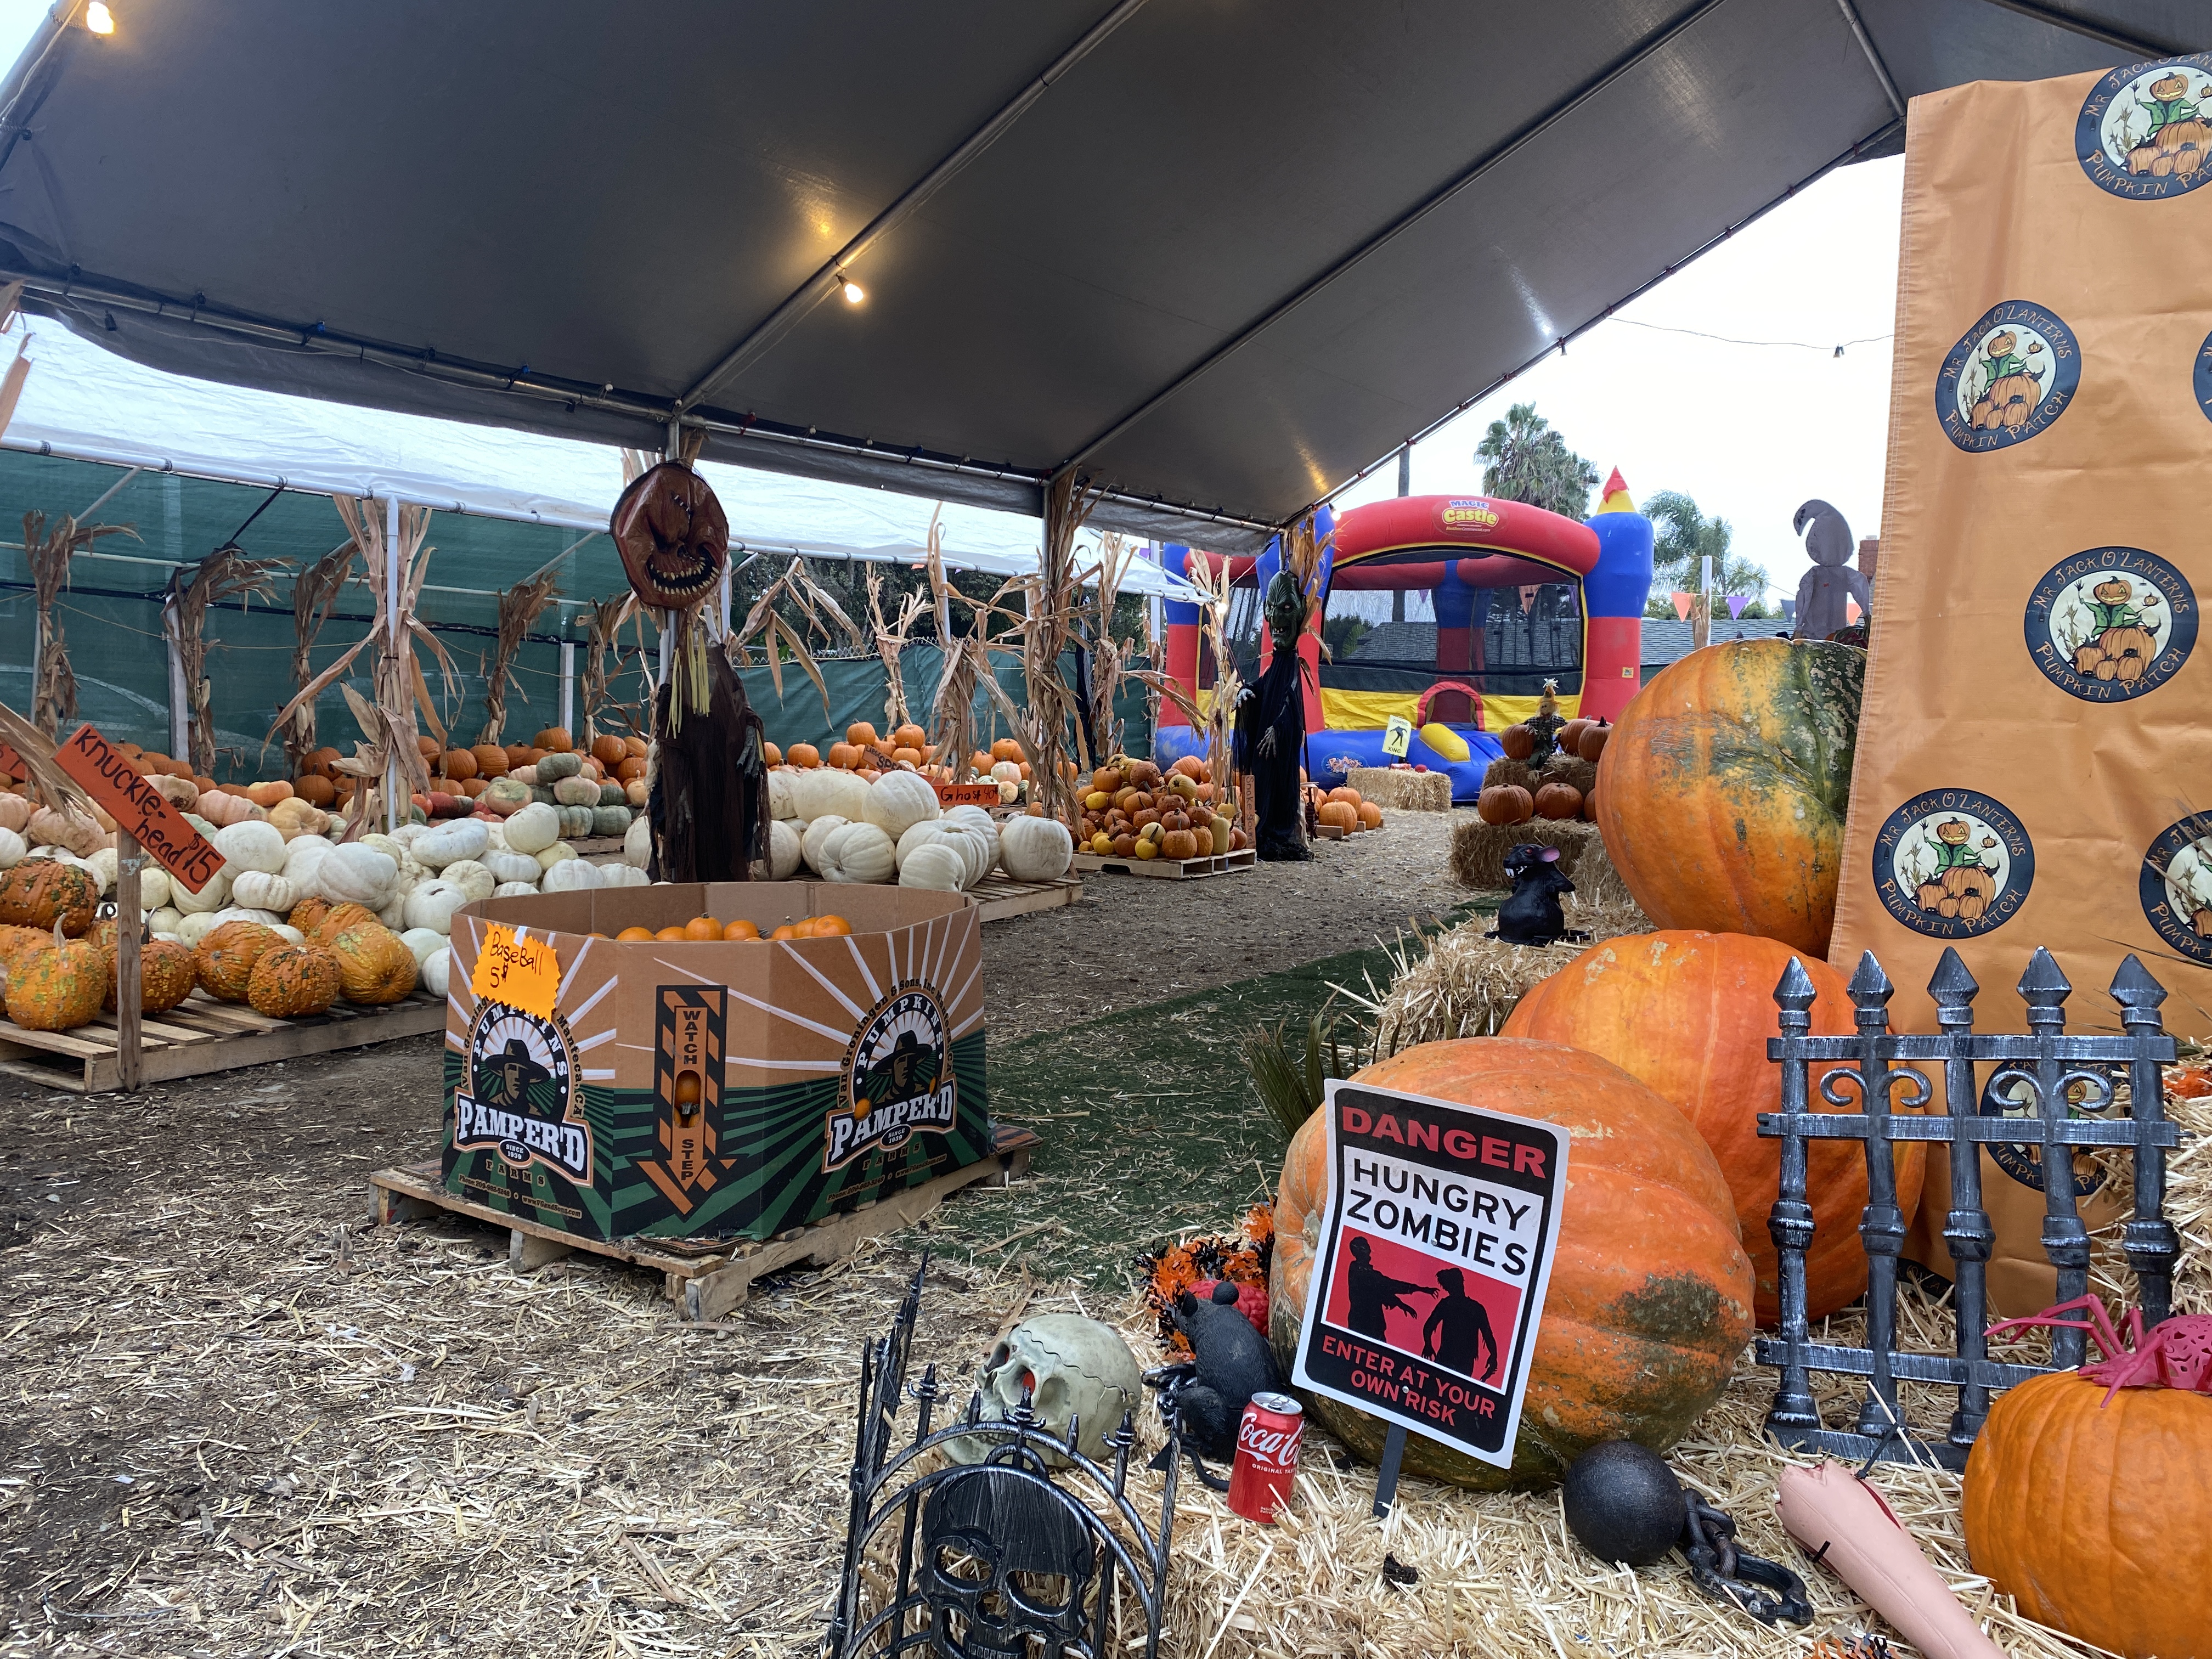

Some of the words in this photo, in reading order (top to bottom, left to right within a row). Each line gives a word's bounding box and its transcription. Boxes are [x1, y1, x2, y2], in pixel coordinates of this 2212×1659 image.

[2085, 94, 2111, 117] MR
[2085, 149, 2168, 196] PUMPKIN
[1943, 357, 1966, 379] MR
[1945, 409, 1999, 449] PUMPKIN
[2005, 390, 2069, 440] PATCH
[1443, 509, 1498, 526] Castle
[1450, 500, 1489, 509] MAGIC
[2033, 585, 2057, 609] MR
[2055, 556, 2100, 585] JACK
[2035, 641, 2112, 698] PUMPKIN
[2119, 647, 2186, 695] PATCH
[866, 746, 881, 758] LARGE
[940, 787, 981, 802] Ghost
[134, 819, 188, 867] head
[1880, 825, 1903, 847] MR
[1901, 798, 1941, 824] JACK
[1880, 877, 1954, 935] PUMPKIN
[1961, 888, 2023, 933] PATCH
[683, 1010, 701, 1065] WATCH
[842, 995, 889, 1067] Groningen
[856, 995, 944, 1069] PUMPKINS
[464, 996, 488, 1049] Groning
[573, 1093, 584, 1117] CA
[838, 1072, 849, 1107] Van
[458, 1097, 586, 1172] PAMPER'D
[506, 1144, 524, 1154] SINCE
[507, 1151, 522, 1160] 1939
[864, 1143, 920, 1170] FARMS
[888, 1127, 905, 1139] SINCE
[888, 1134, 903, 1143] 1939
[1341, 1105, 1547, 1180] DANGER
[486, 1160, 544, 1185] FARMS
[681, 1138, 695, 1181] STEP
[1353, 1158, 1532, 1231] HUNGRY
[1346, 1189, 1527, 1276] ZOMBIES
[1323, 1335, 1396, 1377] ENTER
[1403, 1366, 1429, 1389] AT
[1435, 1377, 1496, 1419] YOUR
[1351, 1370, 1399, 1403] OWN
[1404, 1384, 1455, 1427] RISK
[1252, 1463, 1283, 1474] ORIGINAL
